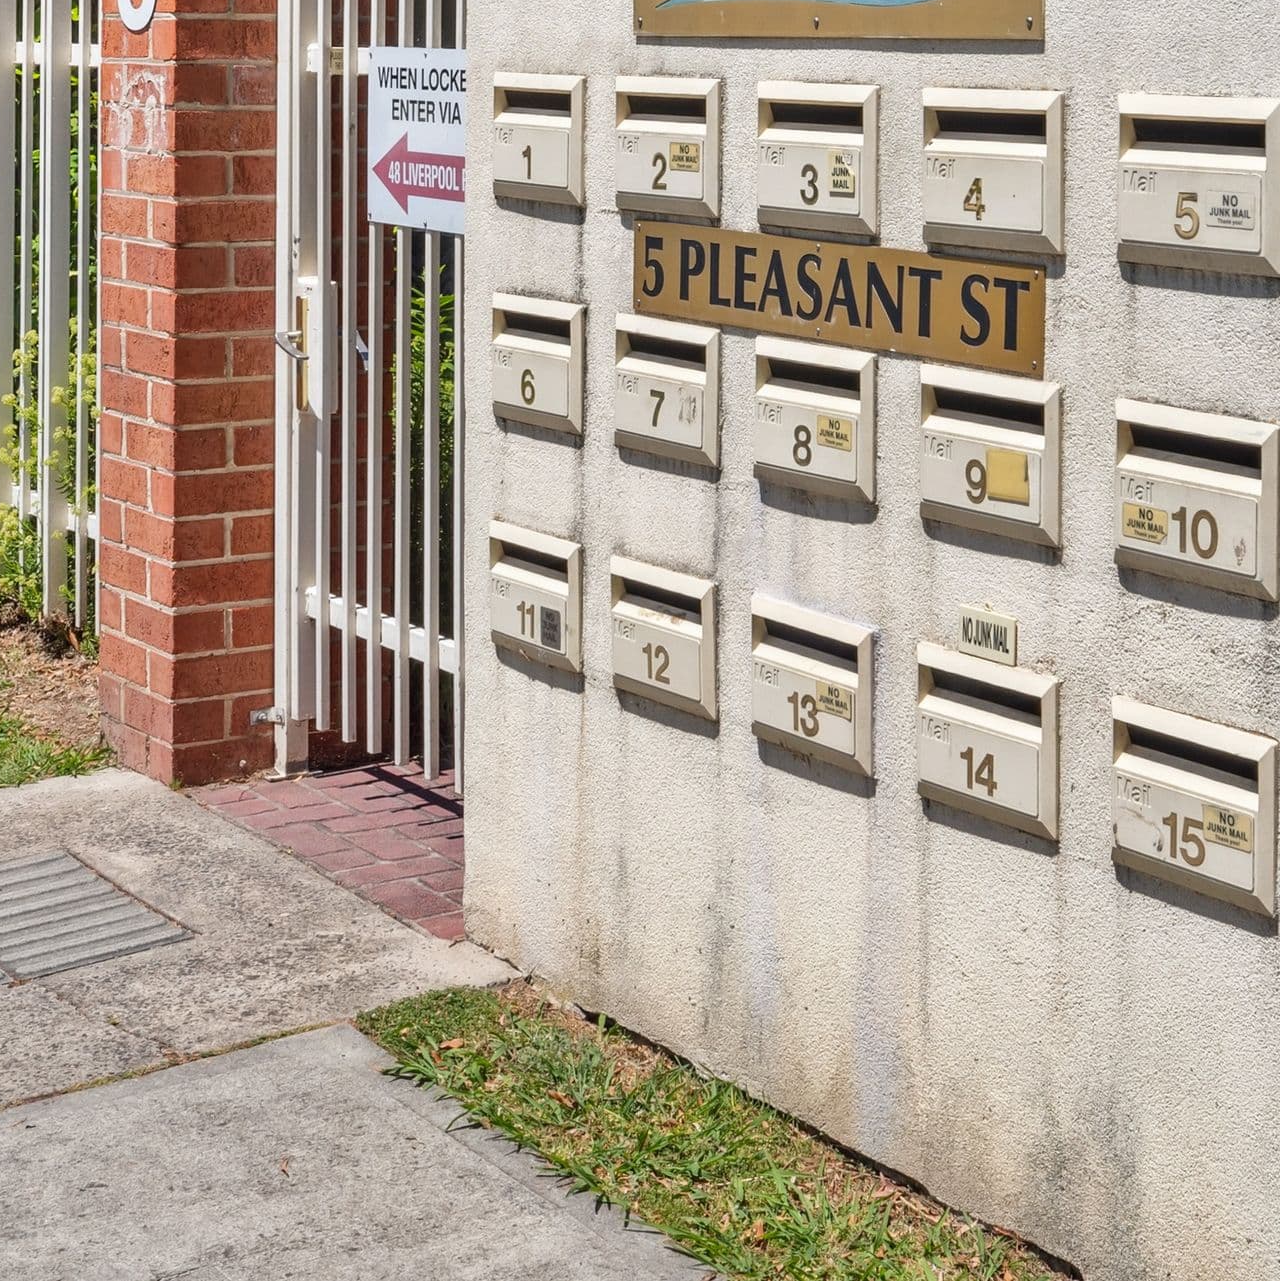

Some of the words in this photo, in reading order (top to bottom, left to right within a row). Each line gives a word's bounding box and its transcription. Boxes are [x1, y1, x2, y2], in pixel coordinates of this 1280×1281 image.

[378, 66, 417, 90] WHEN
[392, 99, 435, 123] ENTER
[439, 102, 462, 125] VIA
[521, 145, 532, 179] 1
[680, 144, 689, 154] NO
[388, 160, 400, 184] 48
[402, 162, 460, 191] LIVERPOOL
[652, 152, 667, 190] 2
[800, 164, 819, 205] 3
[832, 167, 850, 177] JUNK
[832, 179, 850, 189] MAIL
[963, 177, 985, 221] 4
[1174, 192, 1200, 240] 5
[1209, 208, 1230, 218] JUNK
[1232, 208, 1251, 219] MAIL
[1222, 194, 1238, 207] NO
[642, 237, 665, 298] 5
[680, 238, 943, 339] PLEASANT
[959, 274, 1030, 351] ST
[520, 369, 535, 405] 6
[650, 389, 665, 427] 7
[829, 419, 840, 430] NO
[792, 425, 812, 466] 8
[820, 429, 835, 438] JUNK
[836, 432, 849, 442] MAIL
[965, 459, 987, 504] 9
[1126, 520, 1146, 531] JUNK
[1147, 522, 1165, 535] MAIL
[1139, 508, 1154, 521] NO
[1171, 506, 1218, 559] 10
[517, 601, 535, 639] 11
[962, 616, 973, 644] NO
[974, 619, 992, 649] JUNK
[993, 623, 1009, 654] MAIL
[642, 642, 670, 685] 12
[819, 694, 834, 706] JUNK
[835, 699, 849, 711] MAIL
[828, 686, 840, 698] NO
[787, 691, 820, 738] 13
[960, 746, 998, 797] 14
[1206, 822, 1228, 835] JUNK
[1229, 826, 1248, 842] MAIL
[1219, 812, 1236, 827] NO
[1162, 812, 1206, 867] 15
